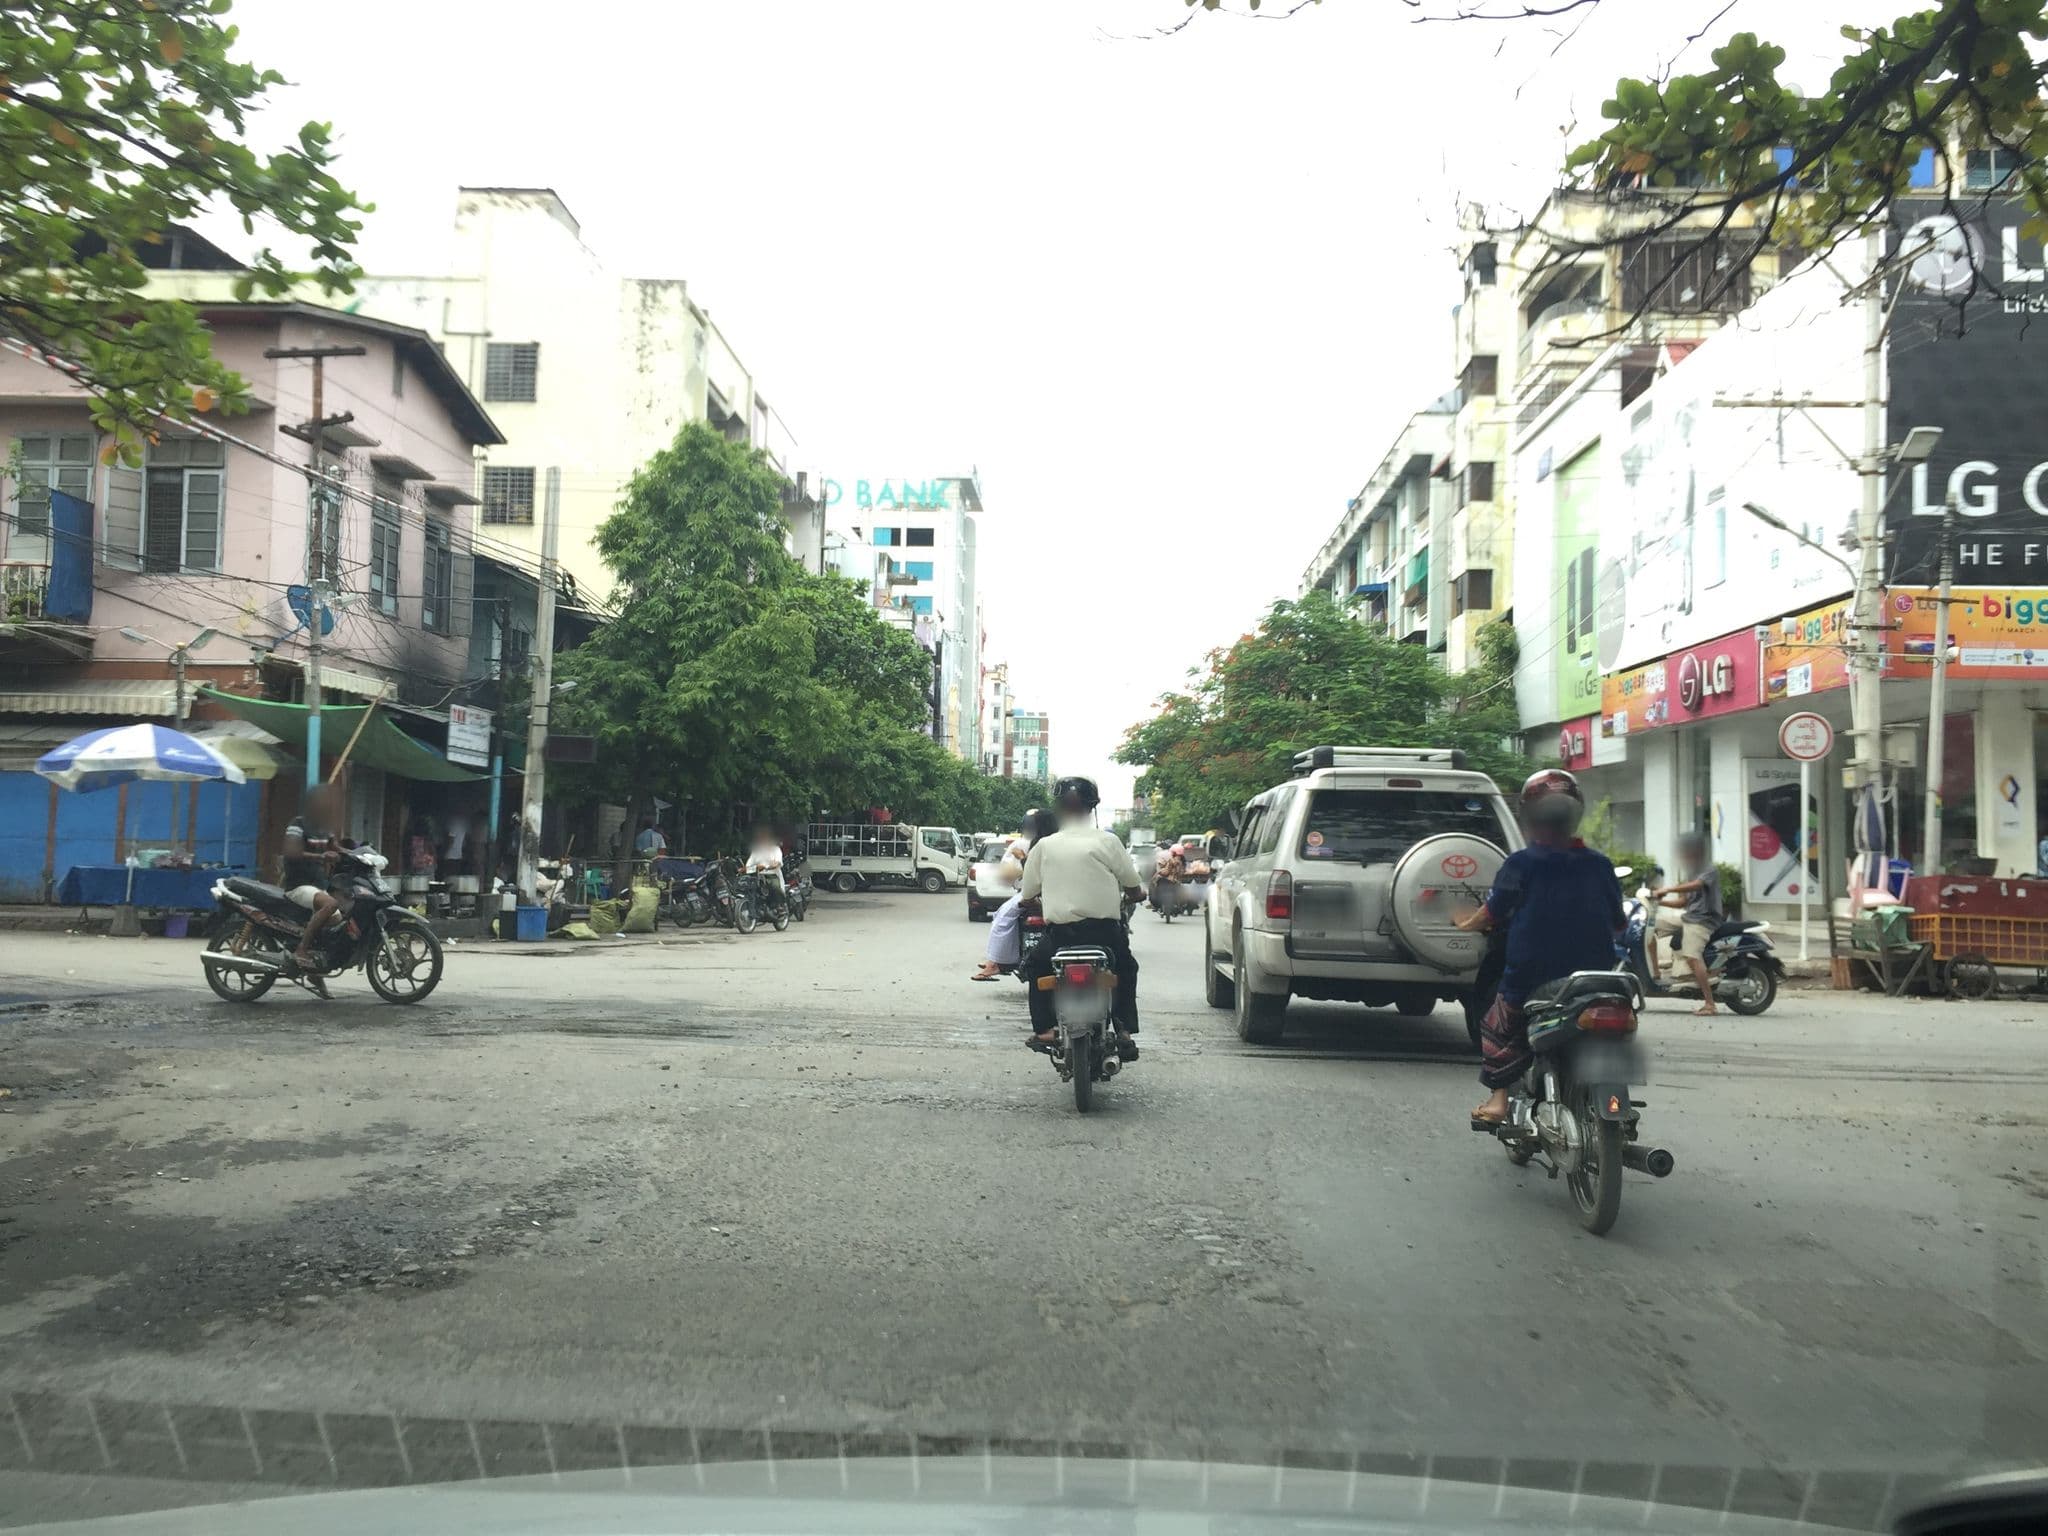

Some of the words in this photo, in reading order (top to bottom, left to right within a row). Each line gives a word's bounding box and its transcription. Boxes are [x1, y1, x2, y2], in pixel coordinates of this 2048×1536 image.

[2002, 226, 2048, 282] L
[856, 479, 950, 508] BANK
[1911, 460, 2000, 517] LG
[1702, 654, 1735, 697] LG
